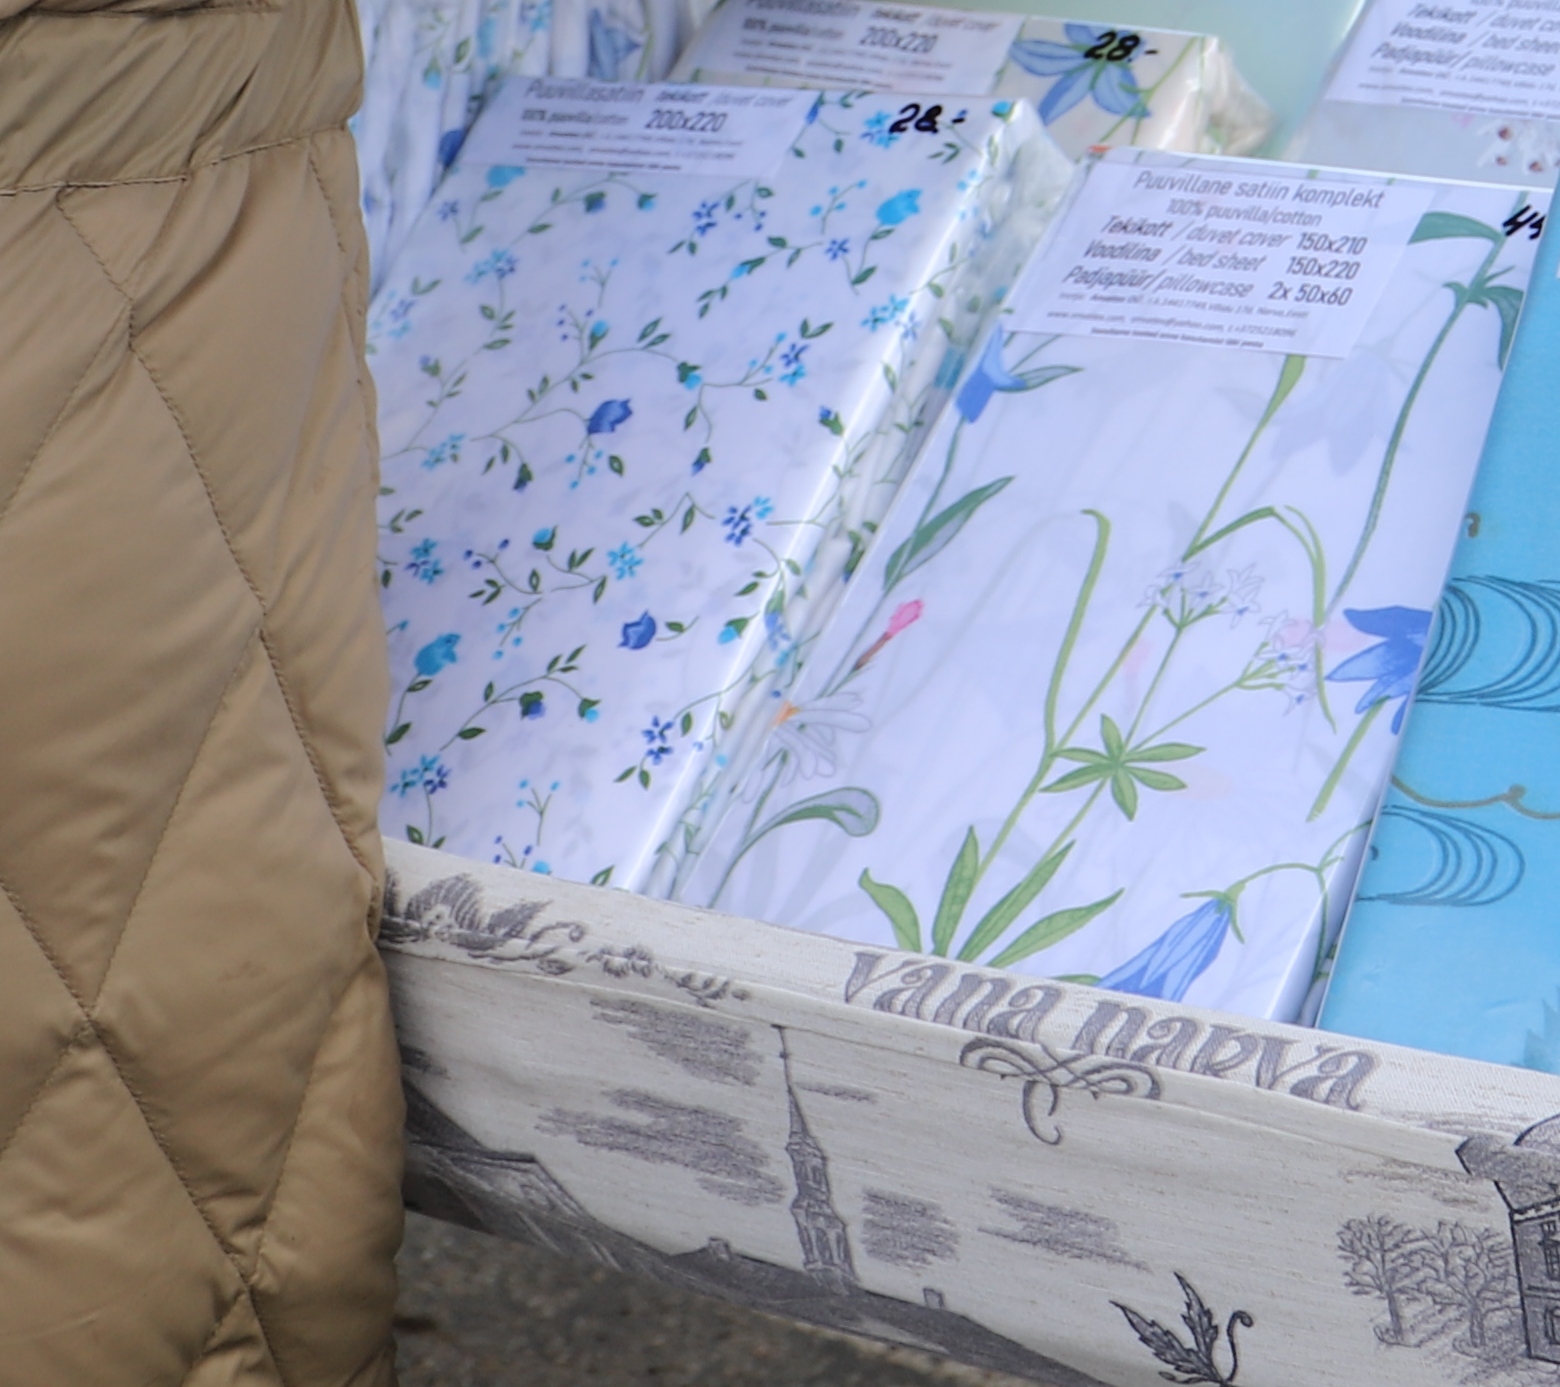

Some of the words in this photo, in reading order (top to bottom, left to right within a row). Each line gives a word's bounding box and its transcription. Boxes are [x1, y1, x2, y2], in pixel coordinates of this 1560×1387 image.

[1133, 170, 1230, 196] Puuvillane
[1234, 178, 1290, 201] satiin
[1293, 183, 1385, 210] komplekt
[1296, 231, 1368, 255] 150x210
[1285, 256, 1361, 280] 150x220
[1267, 280, 1292, 301] 2x
[1294, 283, 1353, 306] 50x60
